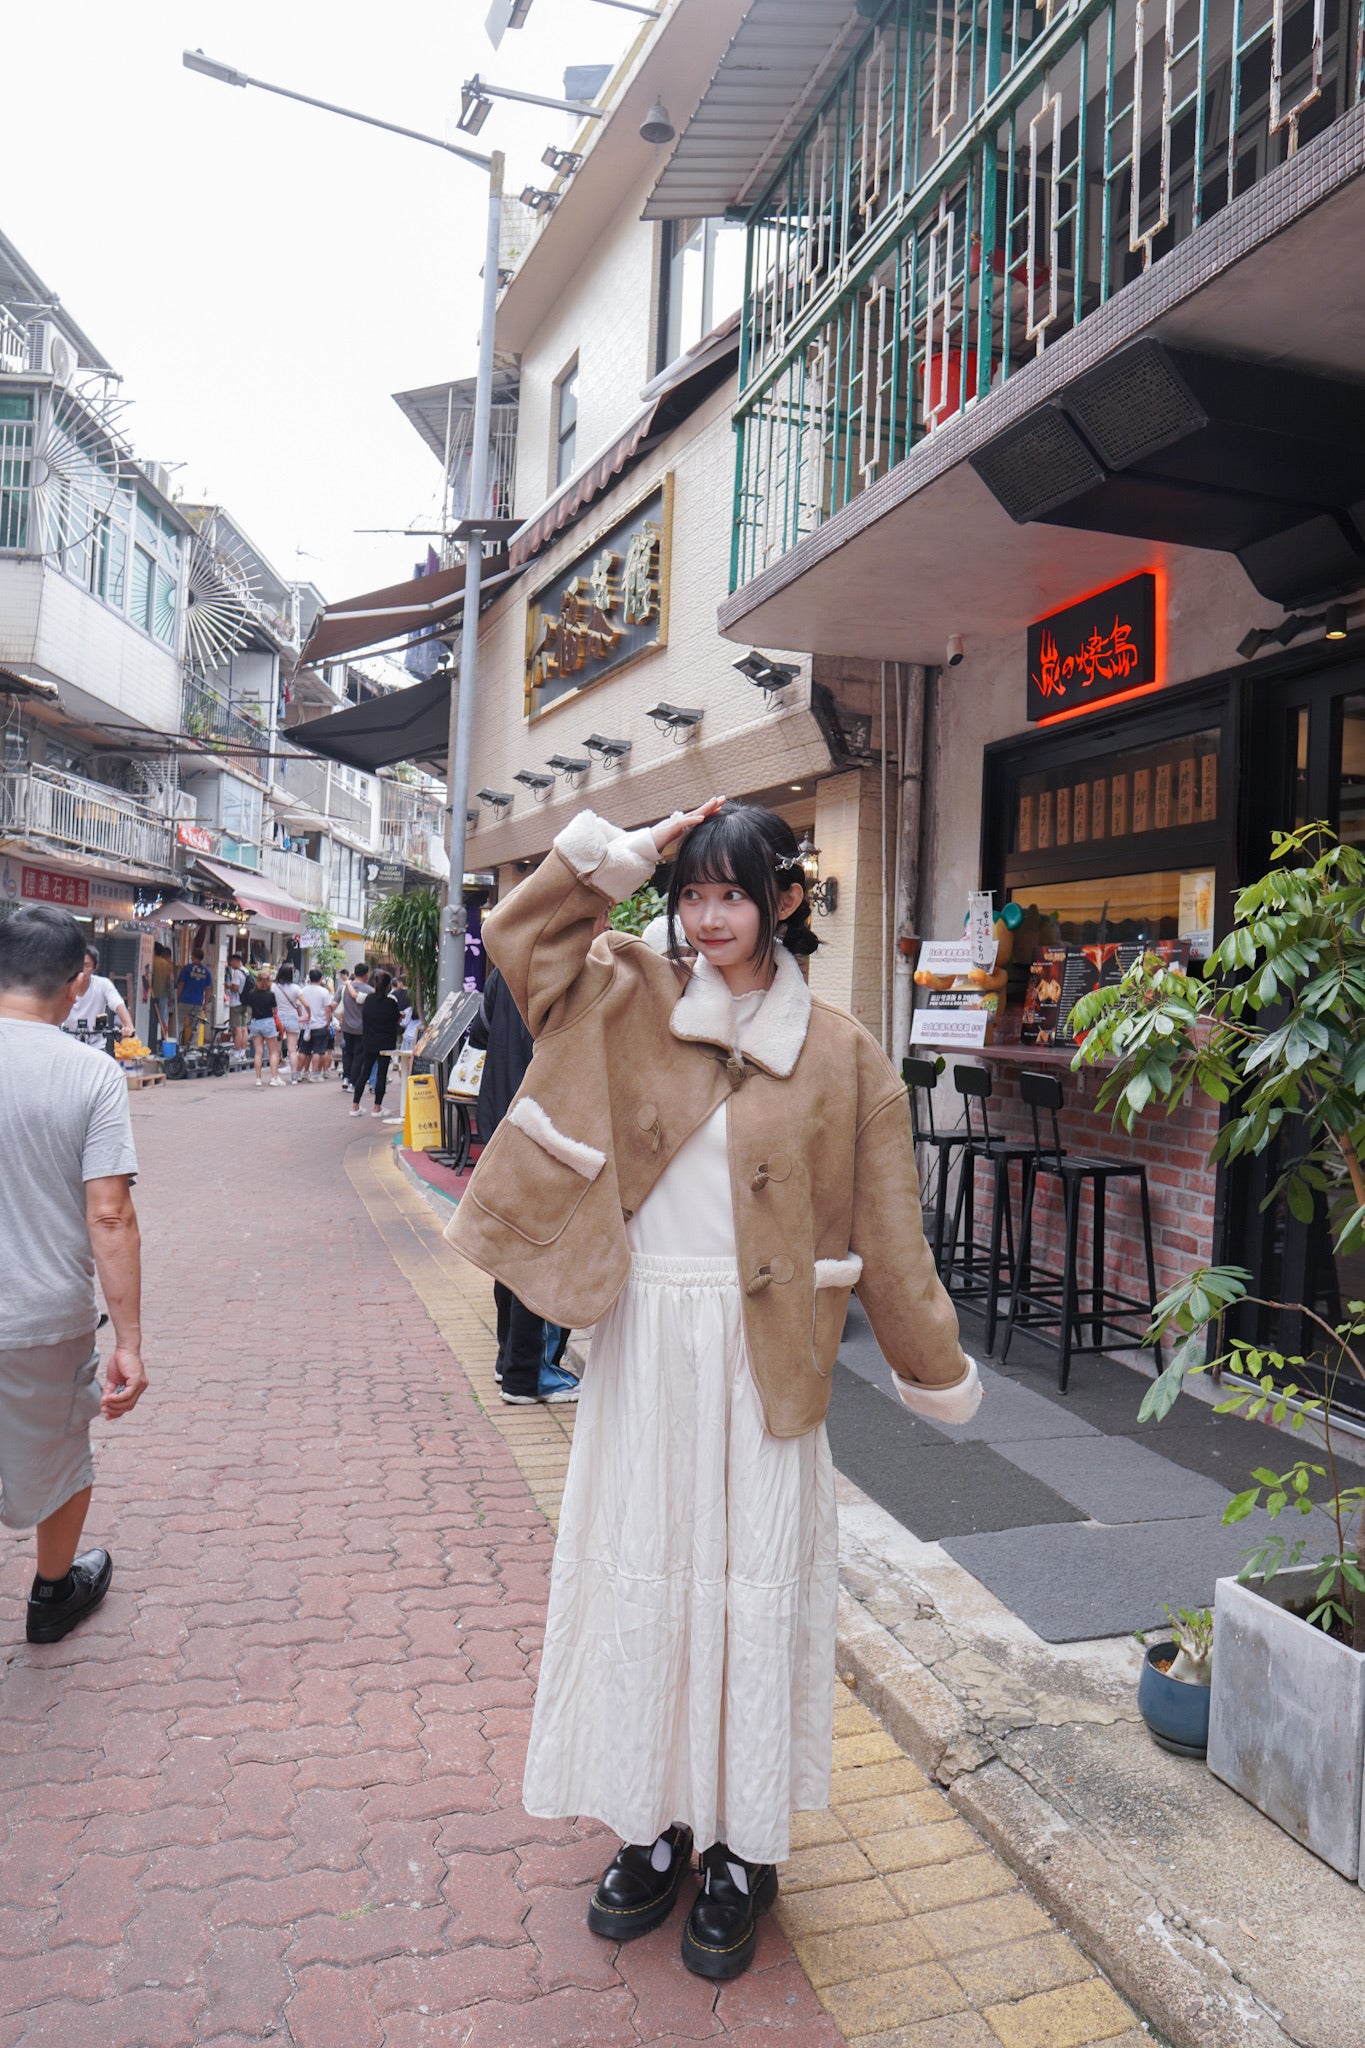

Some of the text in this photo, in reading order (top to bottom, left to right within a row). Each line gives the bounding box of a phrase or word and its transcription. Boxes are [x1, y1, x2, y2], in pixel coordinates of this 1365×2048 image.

[25, 870, 87, 904] 標準石油氣
